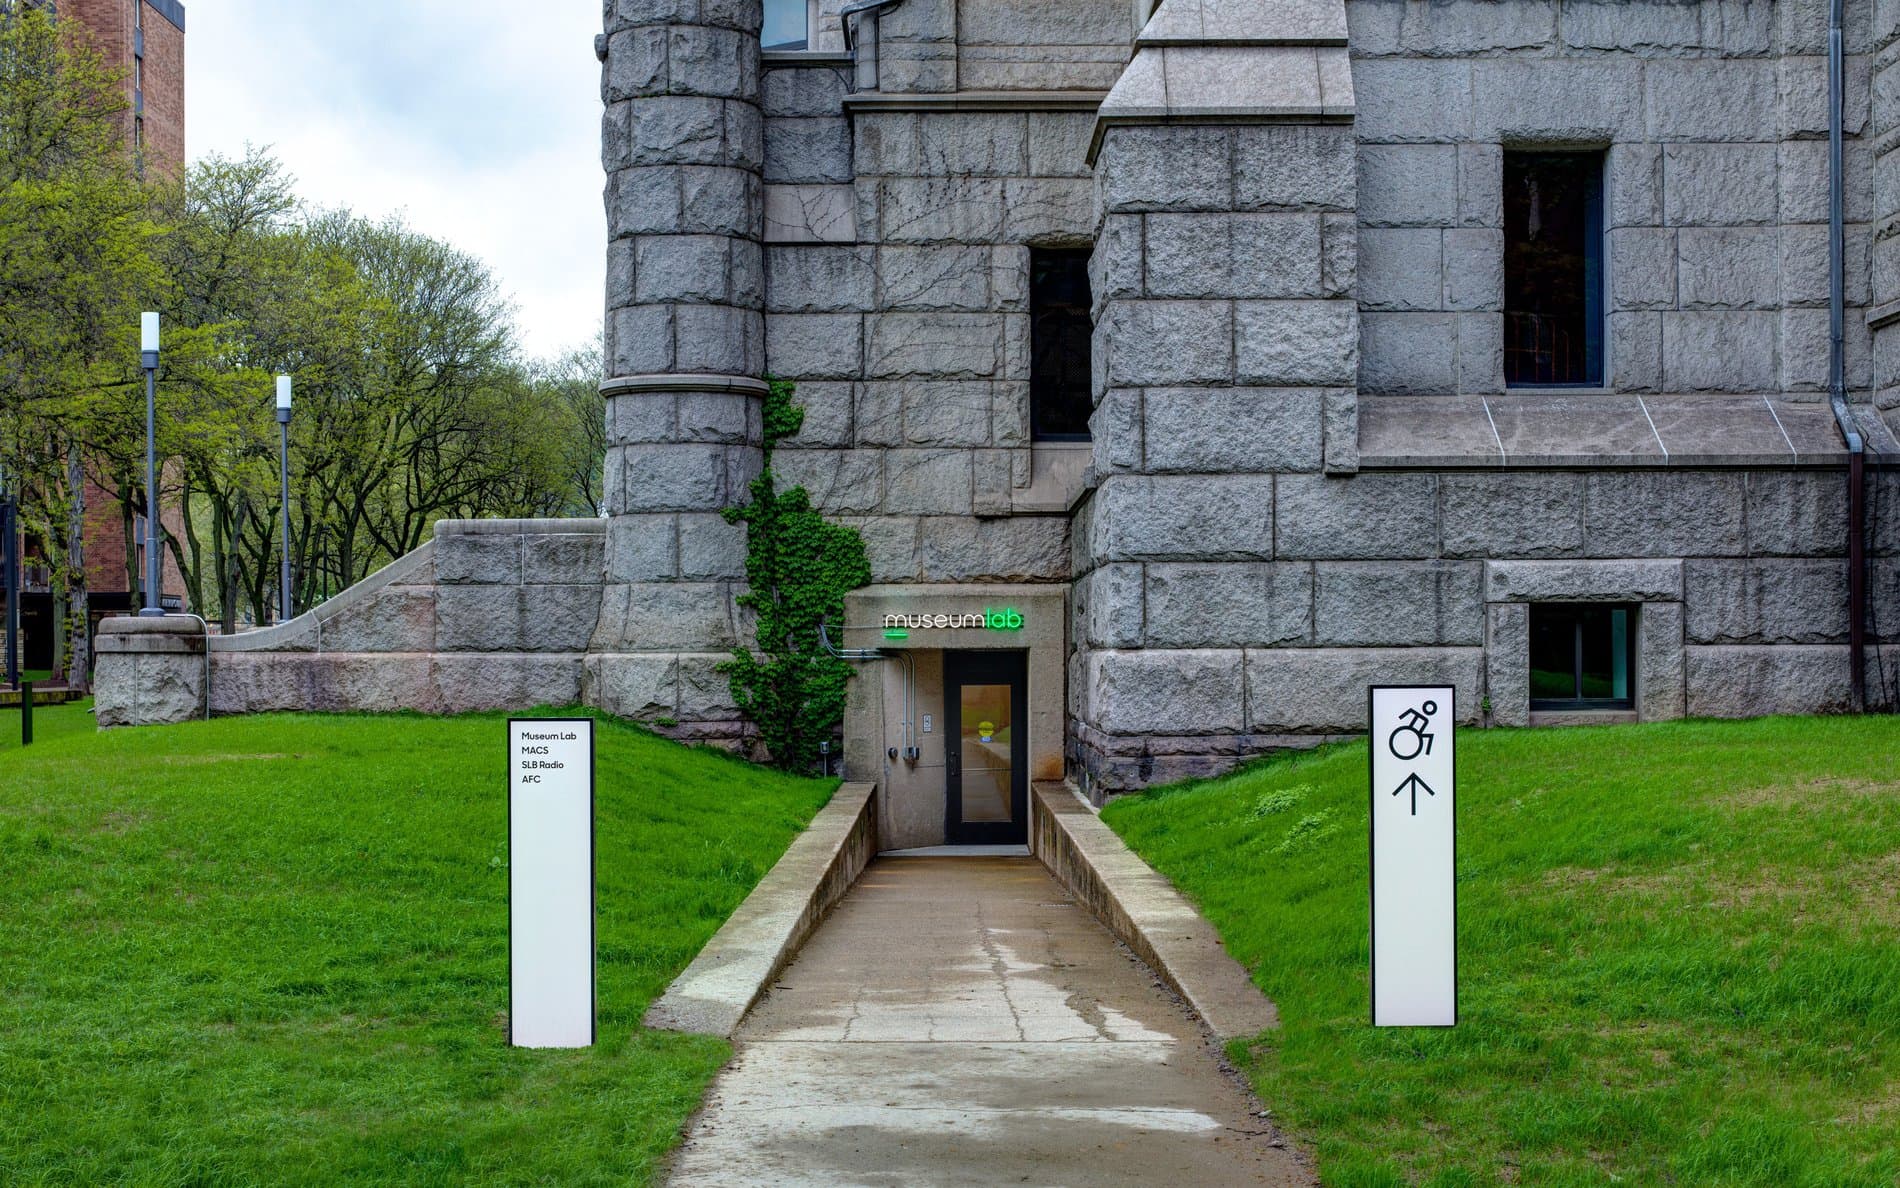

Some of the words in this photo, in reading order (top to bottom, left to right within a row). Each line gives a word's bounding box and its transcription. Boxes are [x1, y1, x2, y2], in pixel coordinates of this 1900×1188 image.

[885, 607, 1022, 629] museumlab
[521, 732, 559, 740] Museum
[560, 732, 577, 740] Lab
[521, 746, 549, 755] MACS
[521, 760, 538, 769] SLB
[539, 760, 564, 769] Radio
[521, 775, 541, 784] AFC
